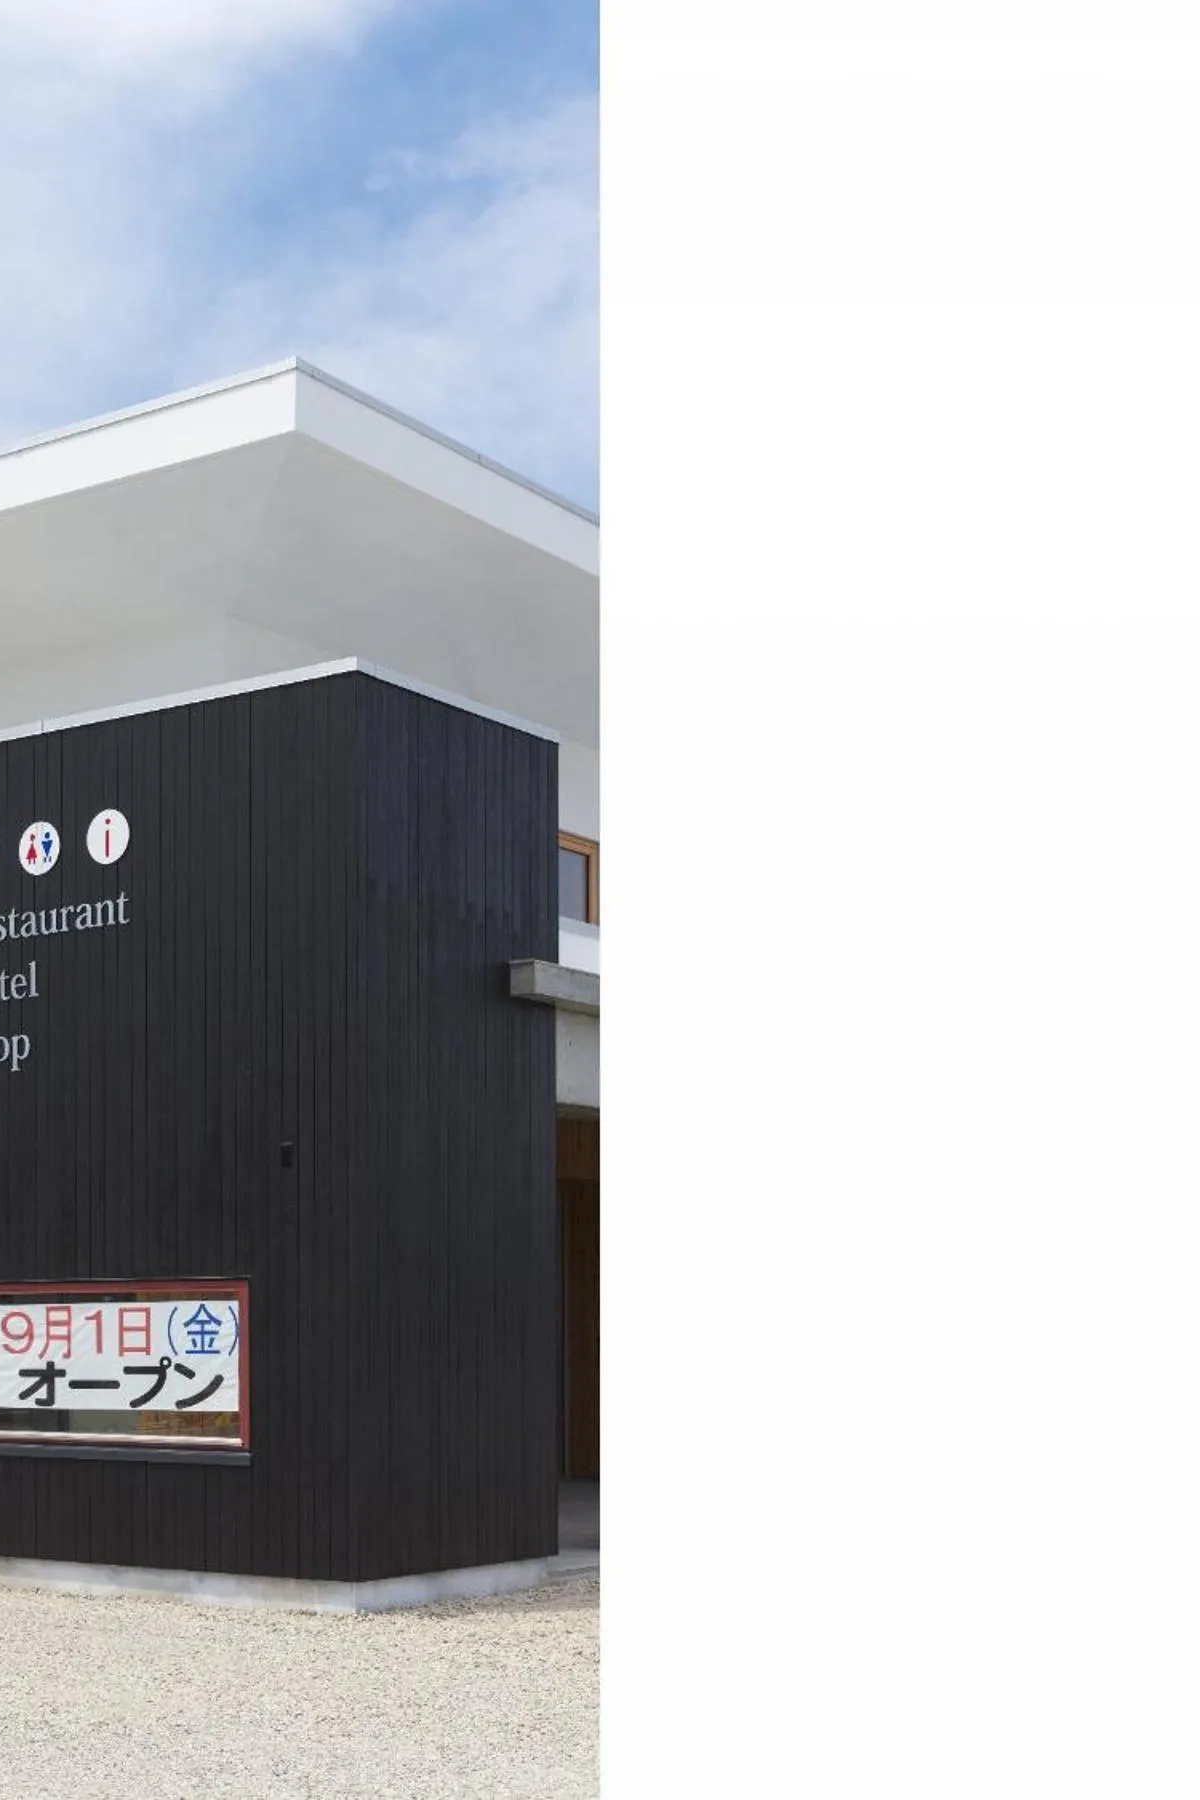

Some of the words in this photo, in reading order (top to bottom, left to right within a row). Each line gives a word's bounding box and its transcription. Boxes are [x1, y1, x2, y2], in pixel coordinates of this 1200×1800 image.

[104, 817, 111, 858] i
[18, 1356, 224, 1410] オープン
